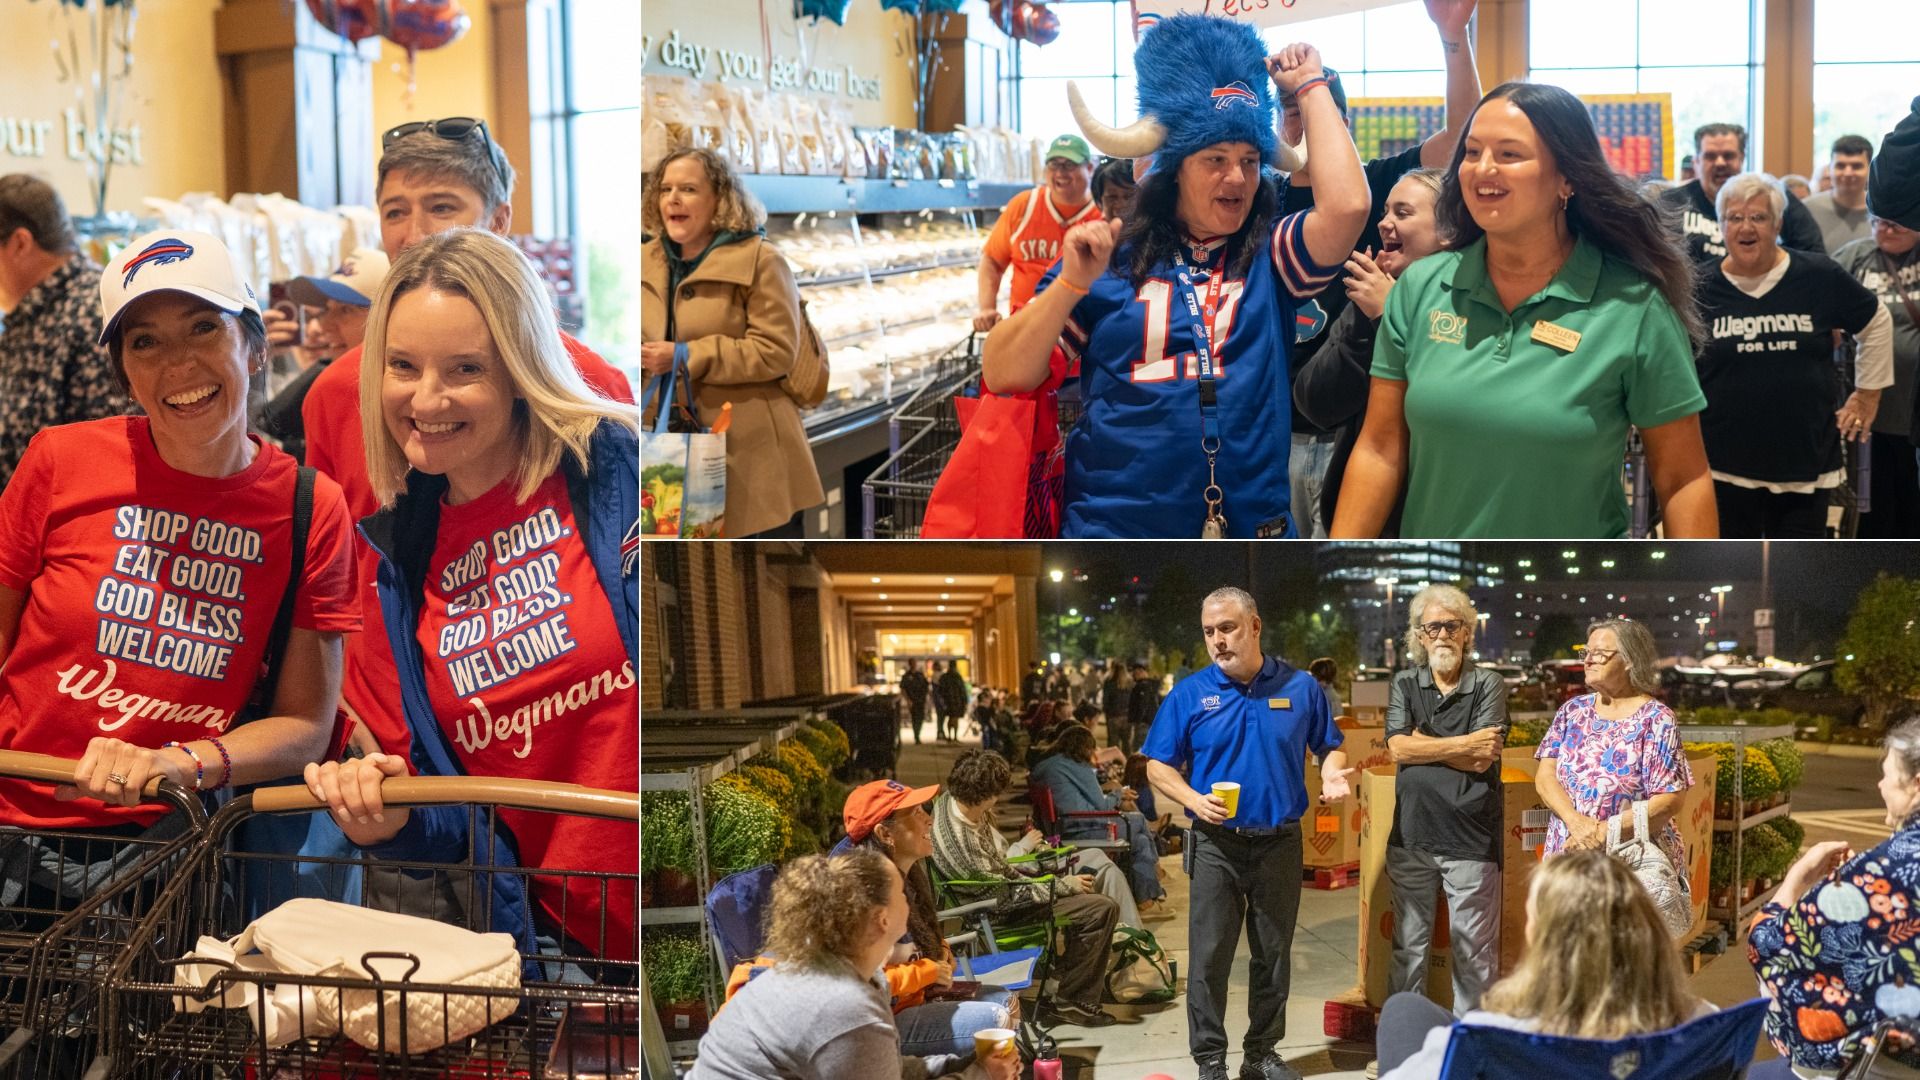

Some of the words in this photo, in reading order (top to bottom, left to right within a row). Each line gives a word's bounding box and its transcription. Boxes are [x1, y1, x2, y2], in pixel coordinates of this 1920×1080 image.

[660, 29, 709, 79] day
[717, 48, 762, 82] you
[769, 54, 801, 91] get
[807, 64, 841, 93] our
[845, 65, 881, 101] best
[1019, 238, 1059, 262] SYRA
[1131, 277, 1246, 383] 17
[1185, 292, 1199, 316] BILLS
[1712, 313, 1814, 341] Wegmans
[1199, 348, 1211, 375] BILLS
[1736, 343, 1765, 353] FOR
[1767, 340, 1798, 351] LIFE
[112, 503, 190, 546] SHOP
[190, 517, 264, 564] GOOD.
[441, 539, 488, 592] SHOP
[491, 506, 572, 566] GOOD.
[114, 543, 171, 583] EAT
[170, 554, 246, 602] GOOD.
[95, 576, 155, 622] GOD
[157, 592, 245, 644] BLESS.
[437, 613, 487, 659] GOD
[96, 618, 233, 681] WELCOME
[446, 612, 577, 699] WELCOME
[453, 658, 637, 760] Wegmans
